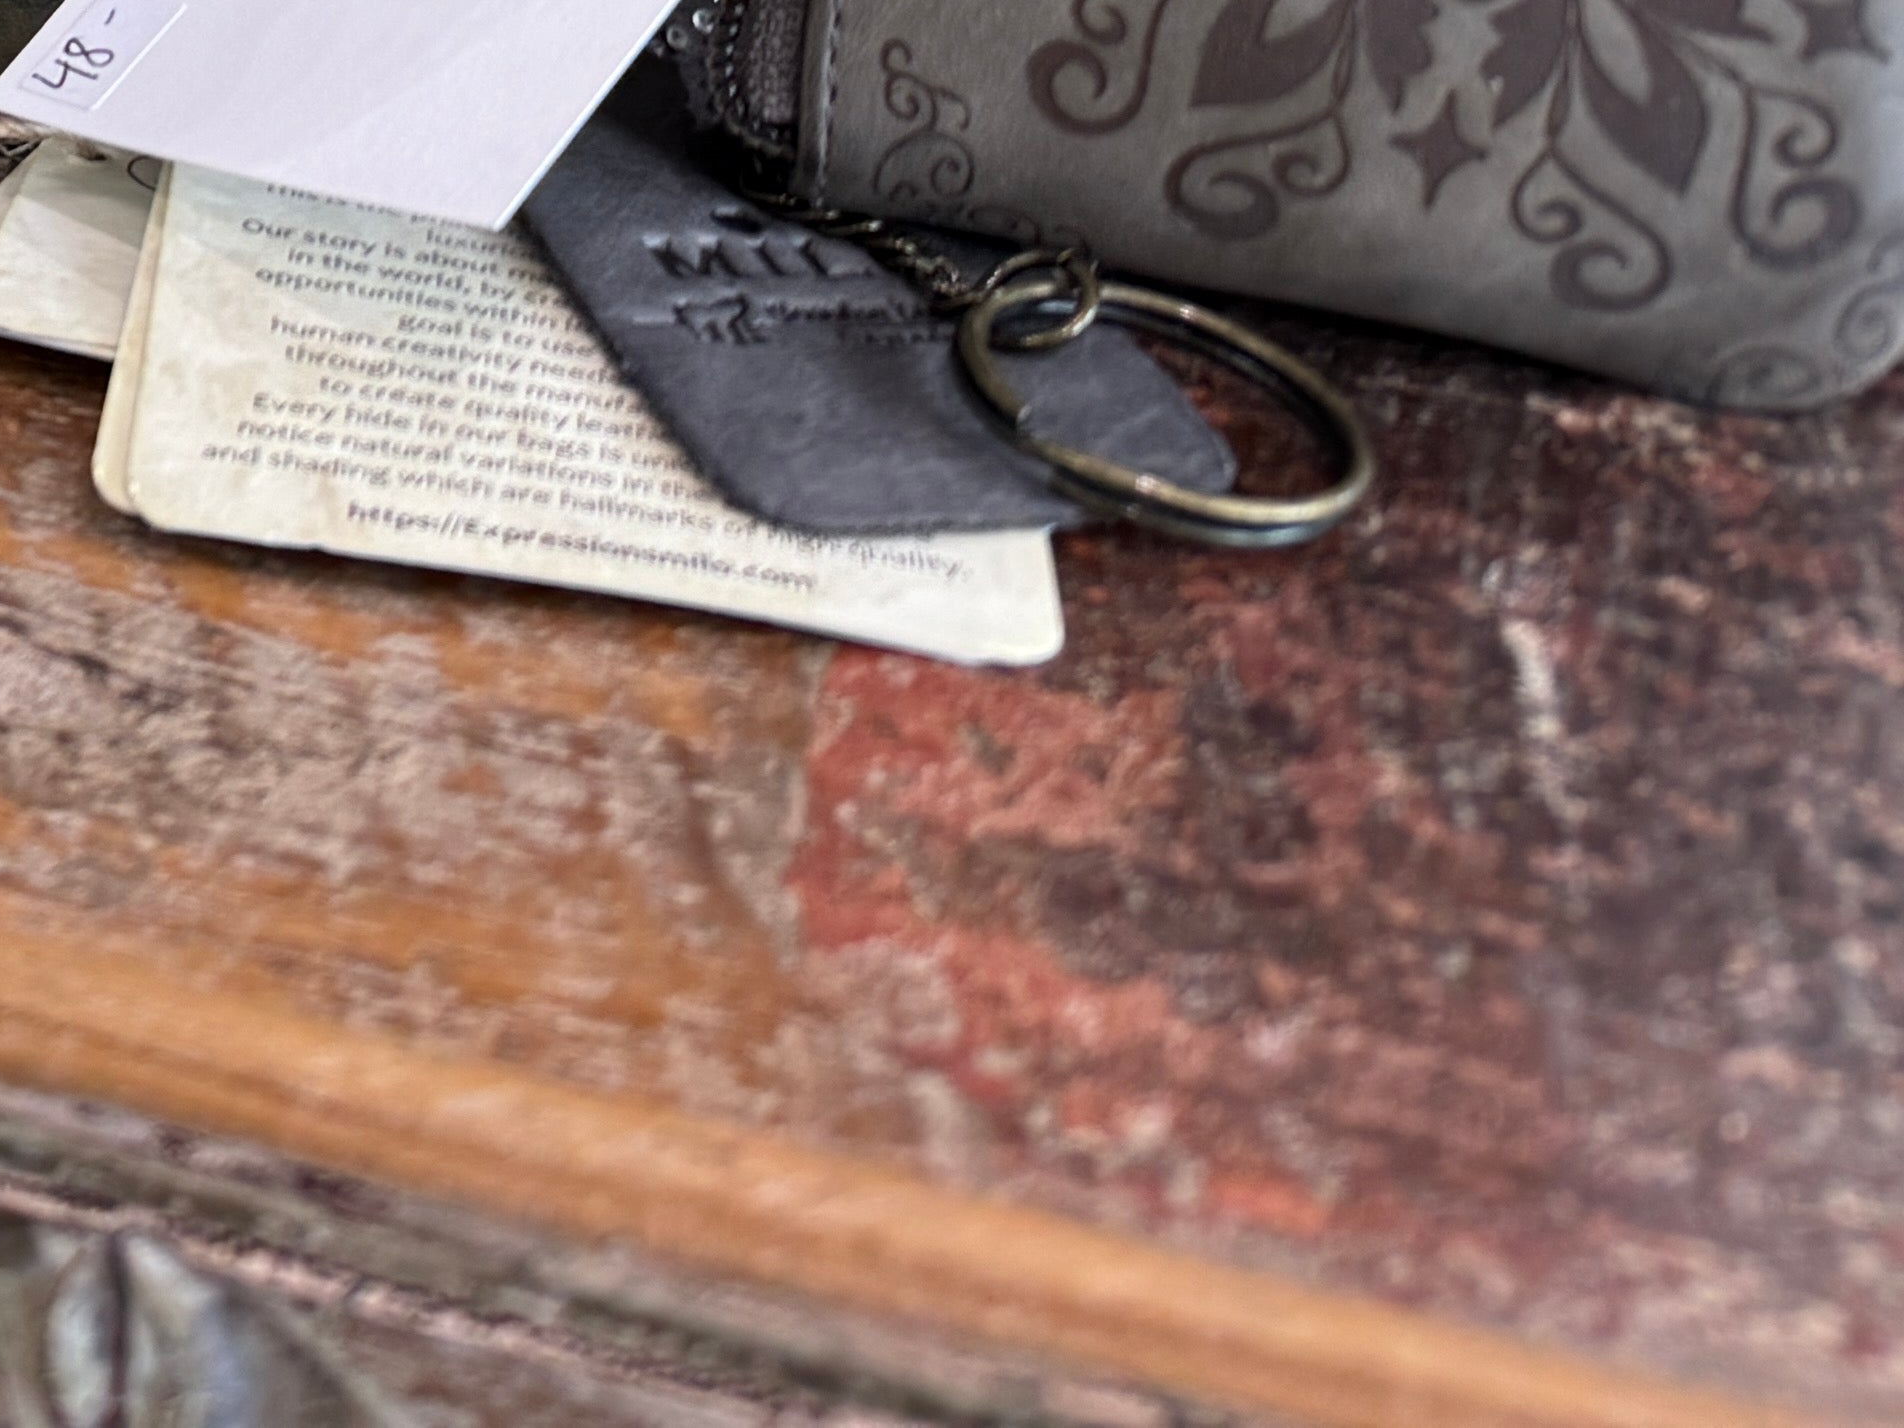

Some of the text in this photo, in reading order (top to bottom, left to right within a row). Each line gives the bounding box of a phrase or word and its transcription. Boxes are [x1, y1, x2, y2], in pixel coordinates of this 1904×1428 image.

[241, 216, 294, 239] Our
[302, 228, 377, 258] story
[384, 239, 406, 261] is
[414, 244, 499, 275] about
[322, 252, 370, 275] the
[255, 266, 457, 313] opportunities
[284, 345, 458, 385] throughout
[252, 390, 336, 423] Every
[201, 441, 263, 466] and
